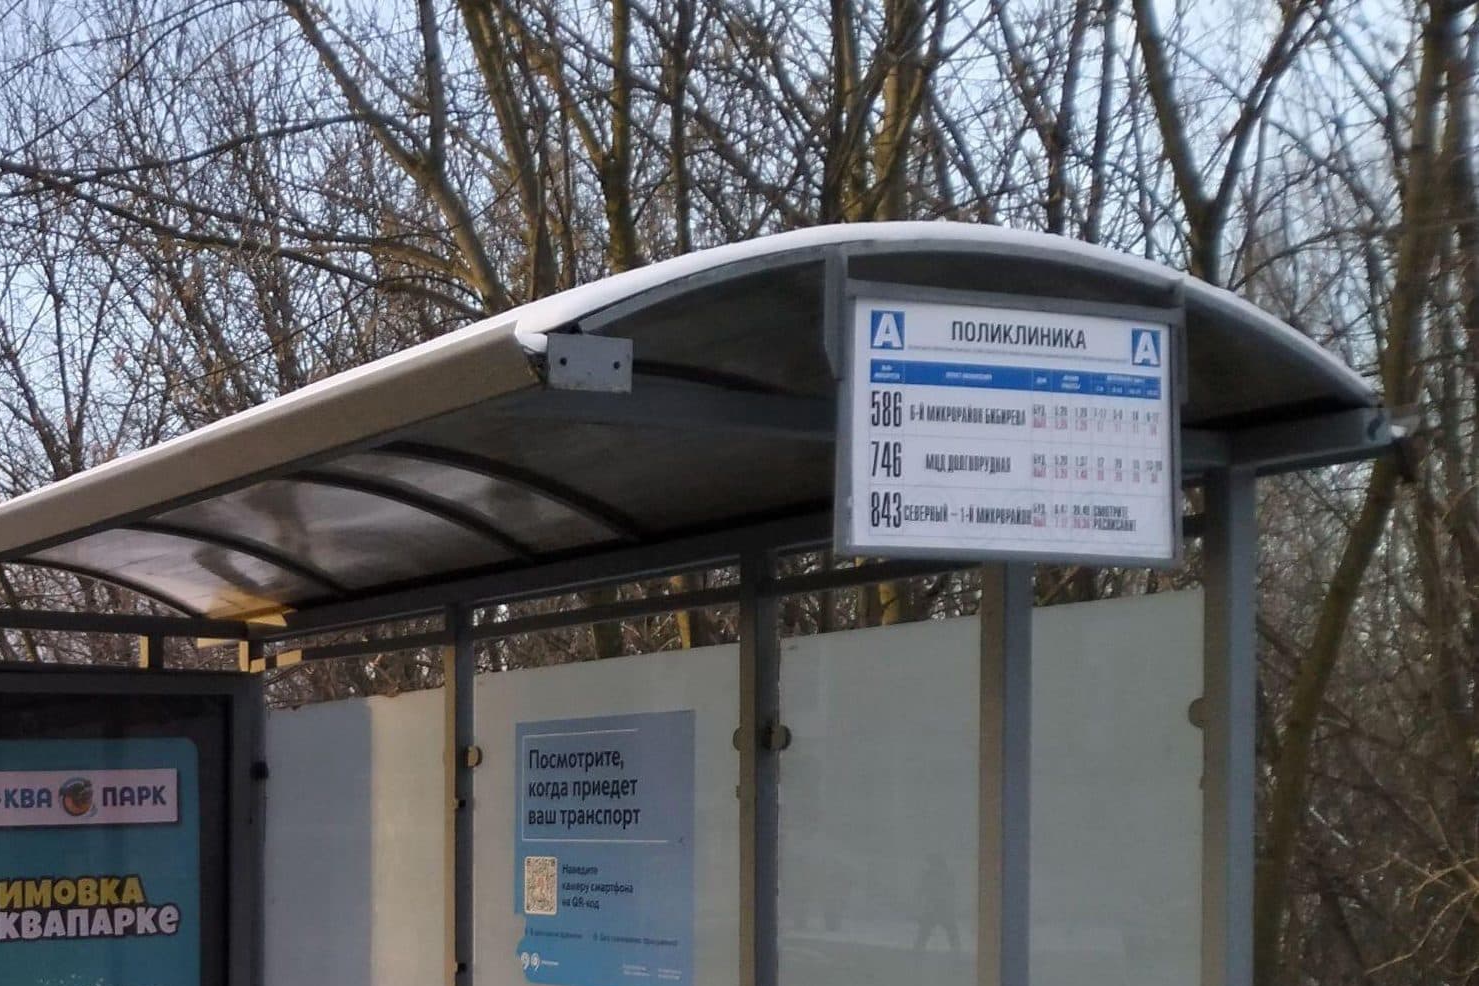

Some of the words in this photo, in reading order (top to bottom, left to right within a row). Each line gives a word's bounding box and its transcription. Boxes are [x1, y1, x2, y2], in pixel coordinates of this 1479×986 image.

[951, 320, 1087, 350] ПОЛИКЛИНИКА
[871, 390, 902, 428] 586
[927, 404, 983, 424] МИКРОРАЙОН
[871, 441, 902, 478] 746
[871, 491, 902, 528] 843
[904, 502, 948, 522] СЕВЕРНЫЙ
[529, 749, 625, 772] Посмотрите,
[102, 785, 167, 807] ПАРК
[528, 781, 568, 800] когда
[572, 779, 638, 801] приедет
[528, 809, 556, 825] ваш
[560, 808, 641, 830] транспорт
[590, 882, 634, 896] смартфона
[572, 896, 600, 910] QR-код
